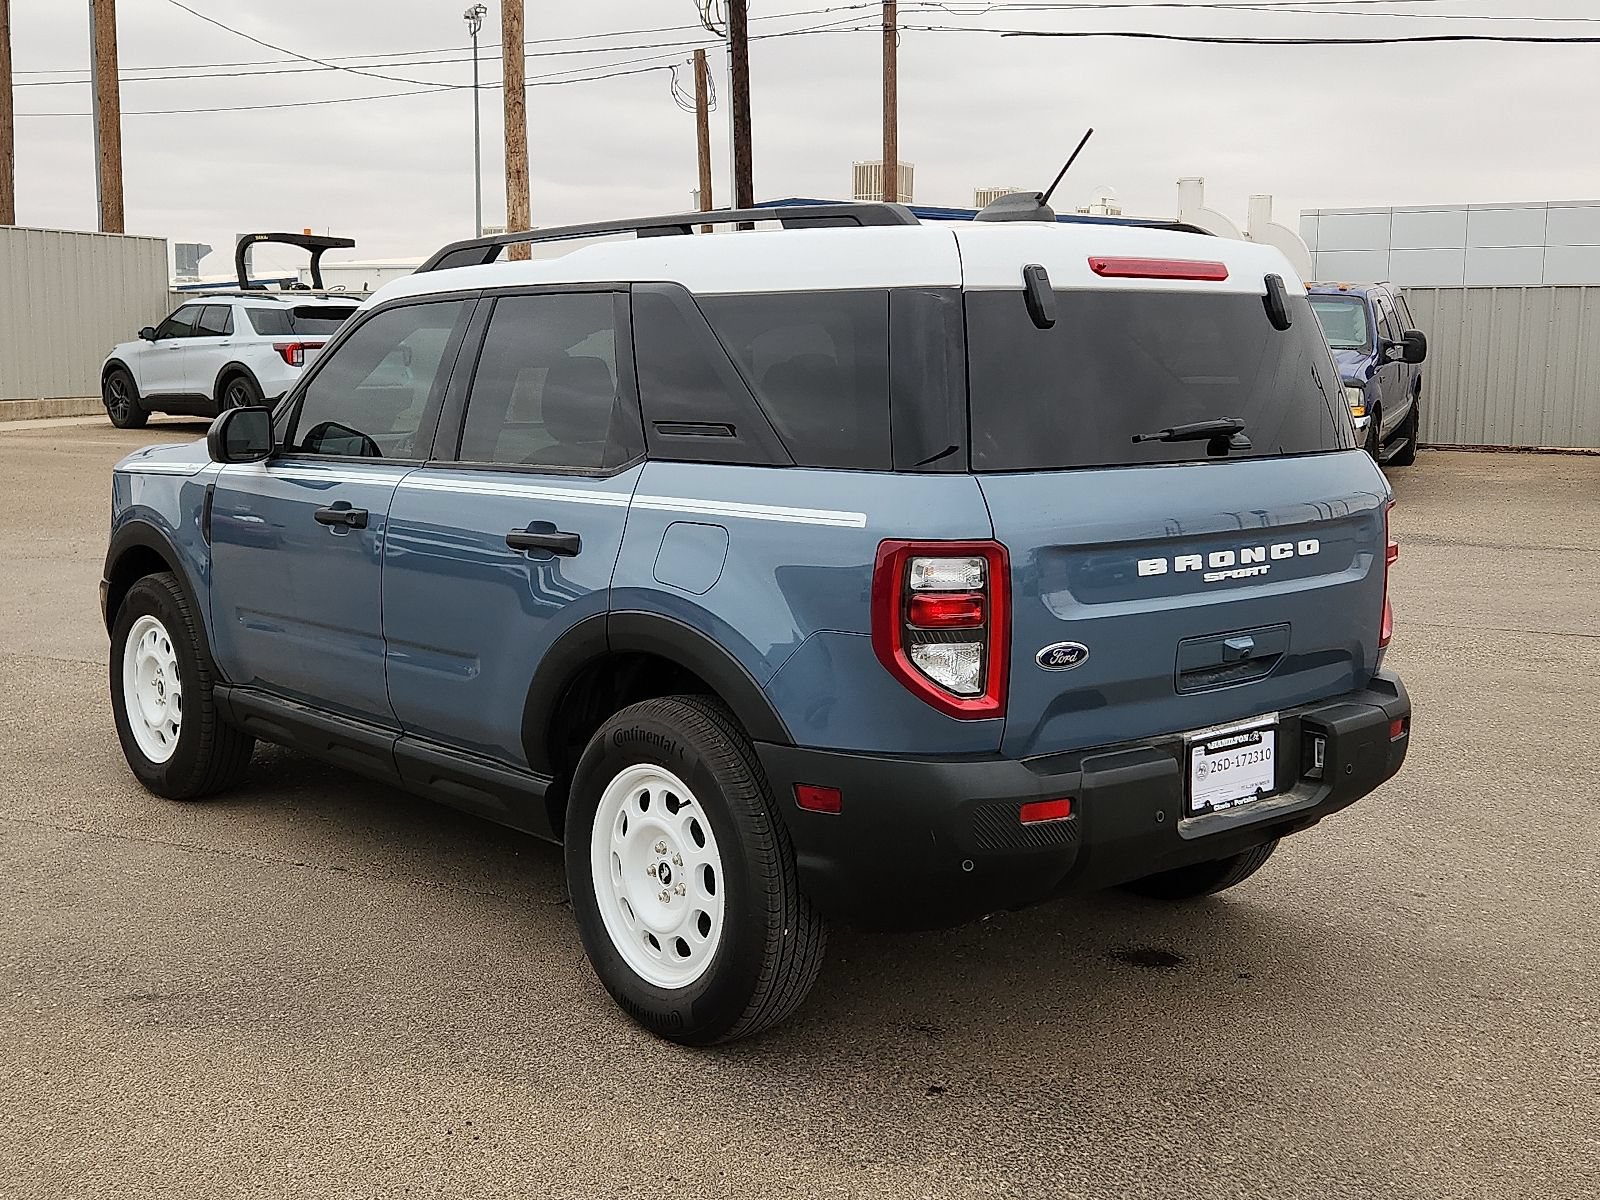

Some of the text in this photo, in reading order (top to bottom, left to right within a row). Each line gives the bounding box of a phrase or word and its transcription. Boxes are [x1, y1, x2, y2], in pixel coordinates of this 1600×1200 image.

[1137, 539, 1320, 577] BRONCO
[1203, 565, 1271, 583] SPORT
[1050, 648, 1079, 665] Ford
[613, 725, 677, 755] Continental
[1210, 748, 1271, 773] 26D-172310
